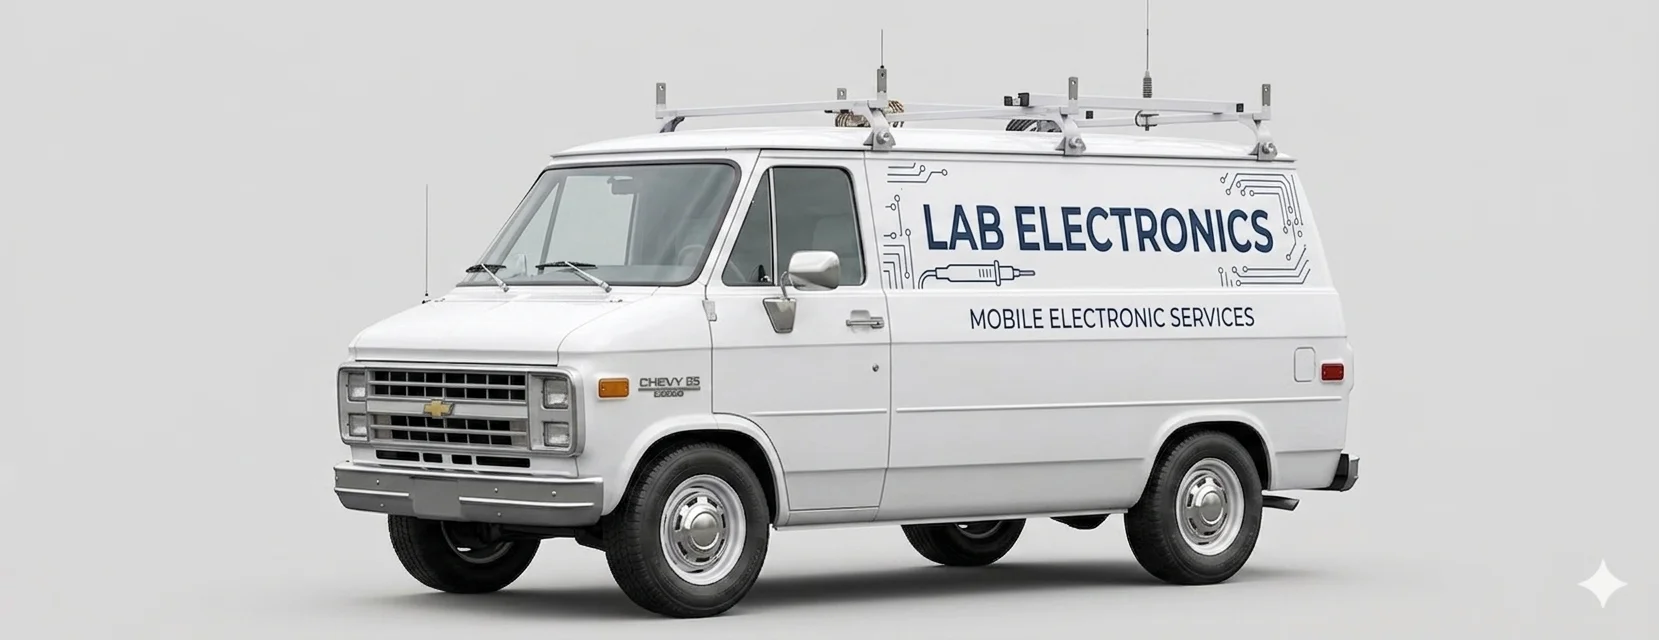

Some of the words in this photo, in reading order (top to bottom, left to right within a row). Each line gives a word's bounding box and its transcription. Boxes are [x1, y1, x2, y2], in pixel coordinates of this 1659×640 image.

[923, 203, 1005, 251] LAB
[1014, 205, 1275, 254] ELECTRONICS
[969, 308, 1044, 330] MOBILE
[1049, 307, 1166, 330] ELECTRONIC
[1170, 306, 1256, 328] SERVICES
[639, 377, 683, 388] CHEVY
